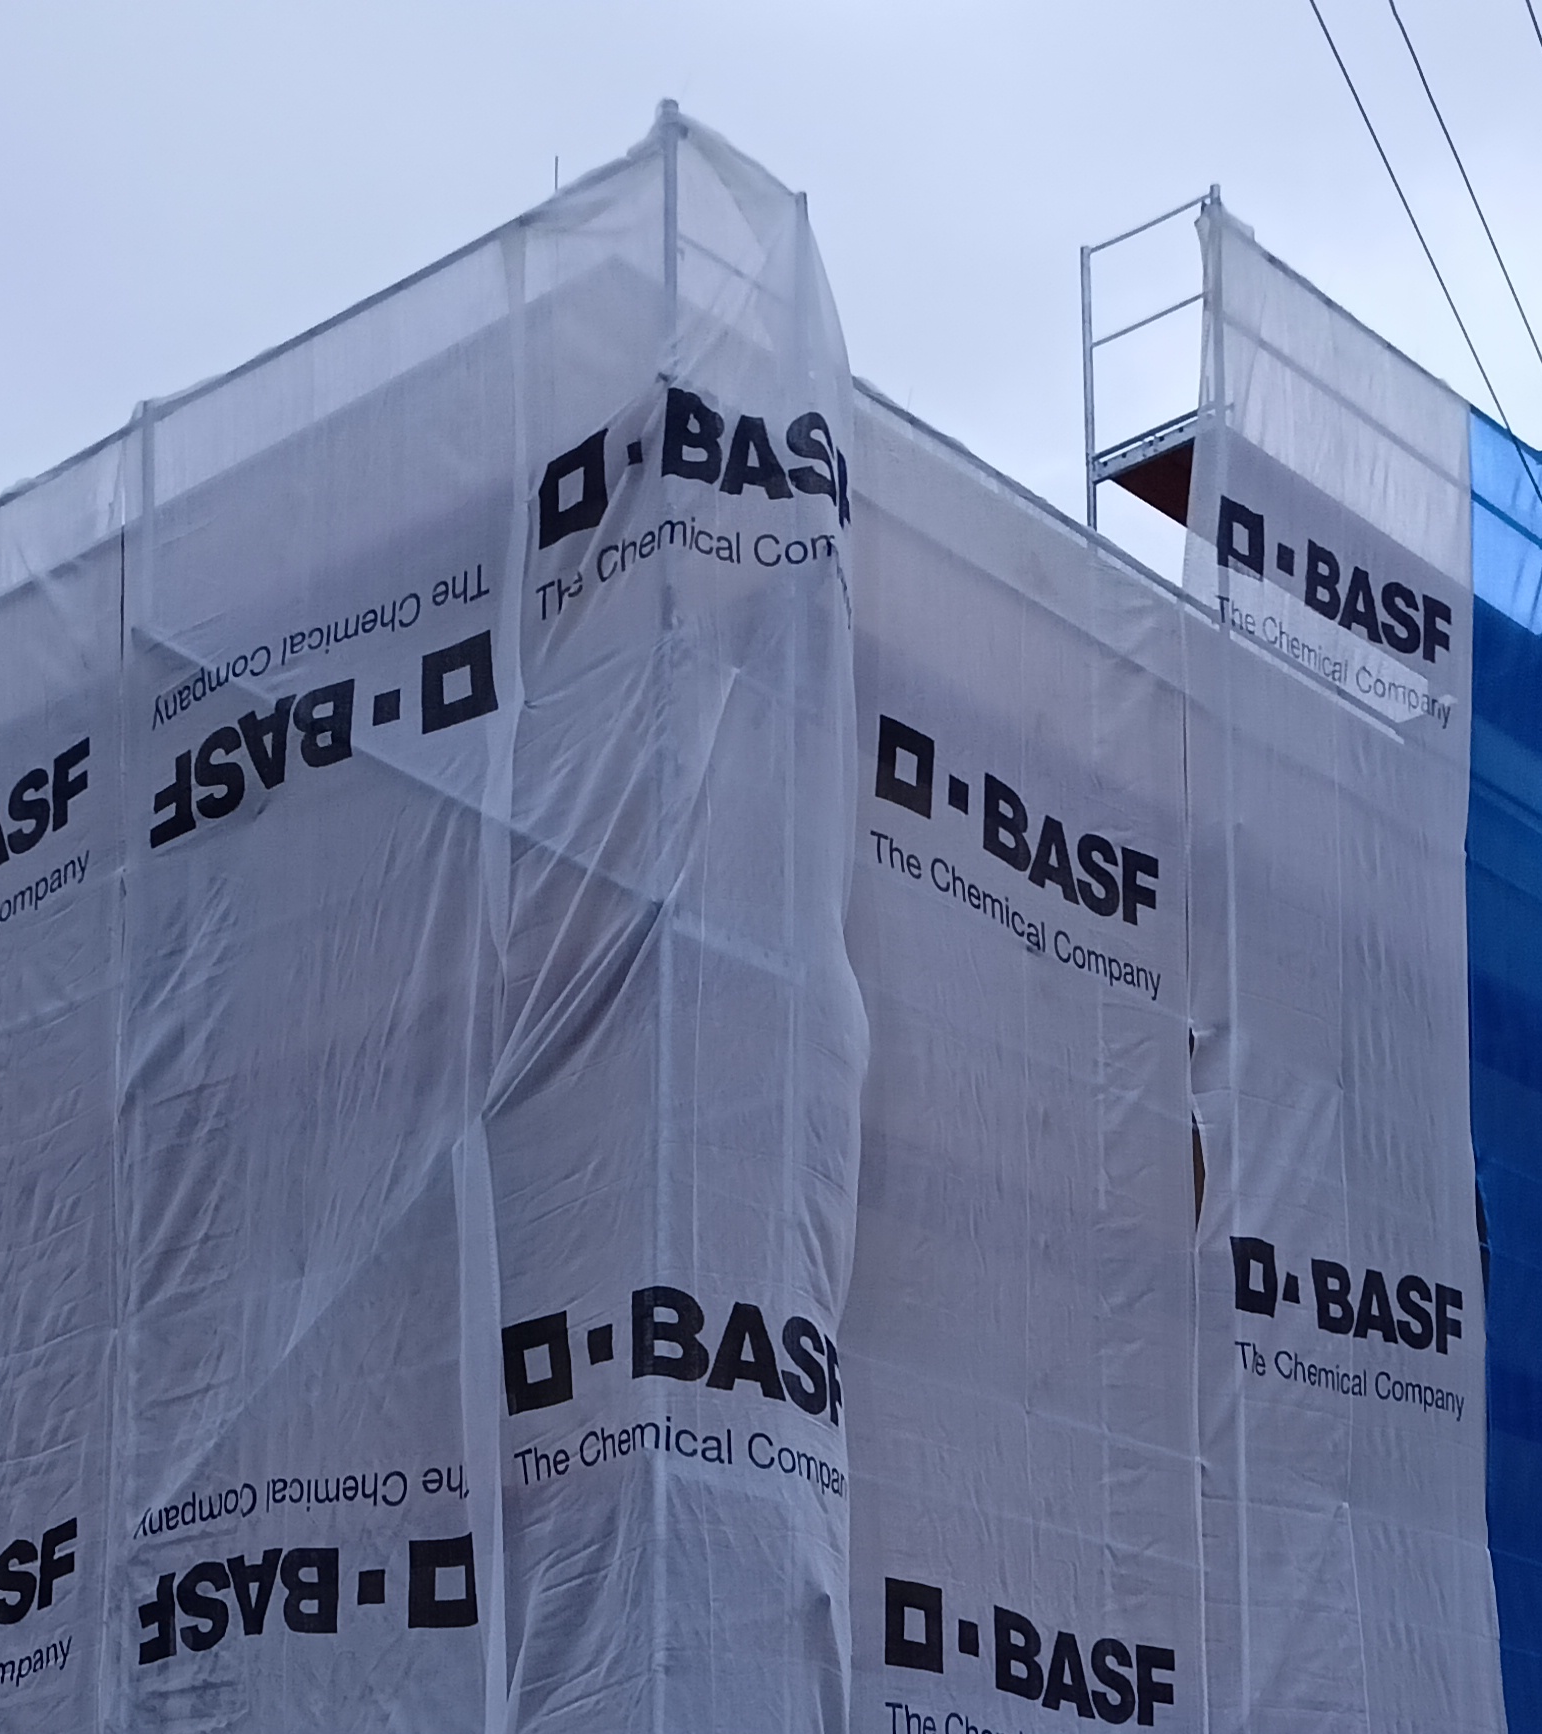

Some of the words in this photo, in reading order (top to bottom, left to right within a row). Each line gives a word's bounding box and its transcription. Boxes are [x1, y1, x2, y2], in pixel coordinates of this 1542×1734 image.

[661, 387, 851, 529] BAS
[432, 564, 490, 609] The
[596, 516, 742, 582] Chemical
[281, 592, 420, 668] Chemical
[1304, 539, 1451, 663] BASF
[150, 644, 272, 730] Company
[1214, 595, 1256, 635] The
[1261, 616, 1349, 684] Chemical
[1355, 665, 1451, 729] Company
[150, 678, 355, 849] BASF
[982, 772, 1159, 926] BASF
[870, 829, 923, 880] The
[930, 857, 1047, 954] Chemical
[1053, 931, 1161, 1001] Company
[1311, 1257, 1463, 1355] BASF
[1274, 1350, 1367, 1397] Chemical
[1375, 1371, 1465, 1422] Company
[265, 1470, 408, 1511] Chemical
[421, 1465, 470, 1500] he
[514, 1449, 570, 1486] The
[579, 1416, 733, 1466] Chemical
[133, 1488, 257, 1539] Company
[139, 1547, 339, 1665] BASF
[994, 1604, 1176, 1728] BASF
